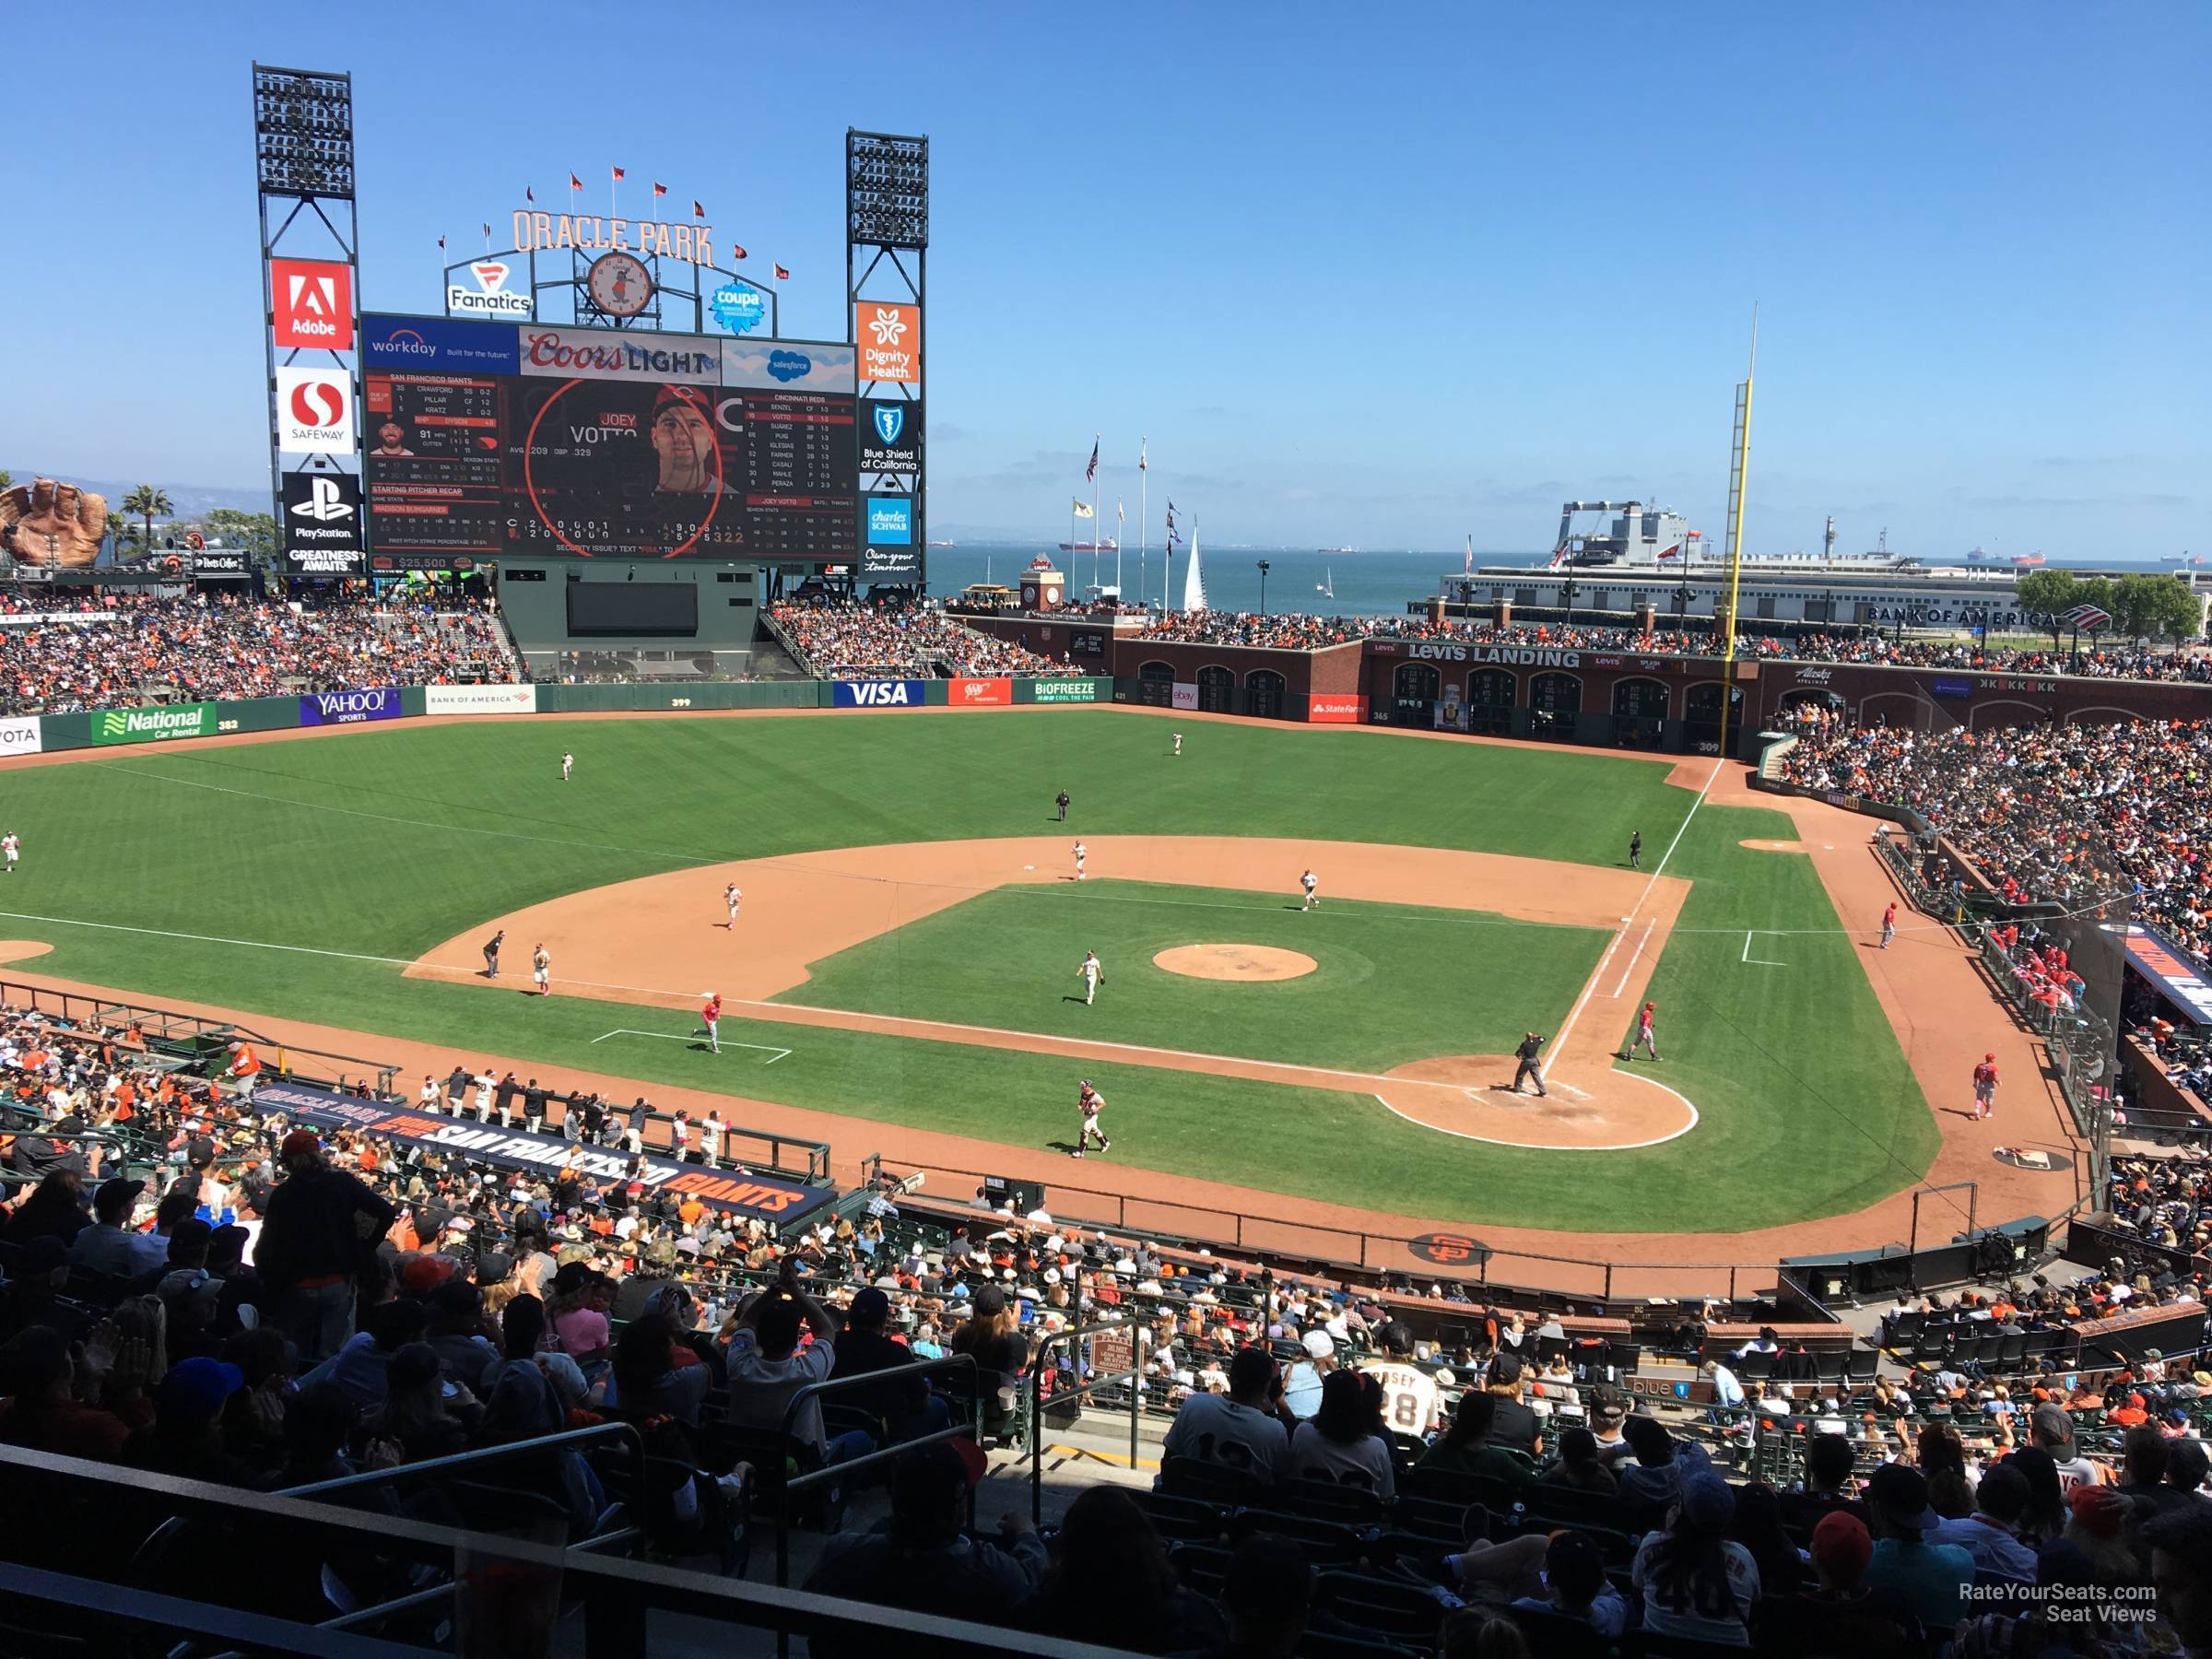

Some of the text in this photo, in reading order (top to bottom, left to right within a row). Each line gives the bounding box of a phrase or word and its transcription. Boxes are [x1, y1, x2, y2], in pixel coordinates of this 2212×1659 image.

[513, 210, 714, 267] ORACLE PARK
[452, 289, 530, 311] Fanatics
[717, 291, 759, 308] coupa
[292, 319, 335, 335] Adobe
[372, 340, 436, 358] workday
[528, 333, 707, 374] Coors LIGHT
[865, 348, 911, 366] Dignity
[772, 360, 807, 371] salesforce
[390, 374, 405, 382] SAN
[406, 375, 445, 383] FRANCISCO
[417, 385, 453, 394] CRAWFORD
[774, 394, 808, 403] CINCINNATI
[601, 415, 636, 426] JOEY
[292, 429, 345, 441] SAFEWAY
[419, 429, 431, 439] 91
[864, 448, 913, 460] Blue Shield
[861, 460, 917, 470] of California
[372, 486, 406, 494] STARTING
[872, 511, 907, 522] charles
[872, 522, 907, 531] SCHWAB
[289, 549, 359, 562] GREATNESS
[865, 548, 913, 564] Own your
[219, 557, 238, 570] Coffee
[399, 557, 446, 568] $25,500
[865, 562, 916, 571] tomorrow
[1868, 606, 2057, 627] BANK OF AMERICA
[1409, 644, 1580, 668] Levi's LANDING
[1795, 666, 1832, 679] Alaska
[847, 682, 909, 705] VISA
[965, 684, 983, 695] AAA
[1173, 689, 1194, 702] ebay
[1114, 692, 1126, 700] 421
[317, 690, 385, 715] YAHOO!
[672, 699, 691, 707] 399
[127, 707, 203, 732] National
[338, 712, 366, 722] SPORTS
[1373, 712, 1388, 721] 365
[218, 720, 238, 730] 382
[154, 727, 200, 739] Car Rental
[1700, 742, 1719, 752] 309
[1828, 793, 1844, 806] KNBR
[253, 1088, 391, 1124] ORACLE PARK
[703, 1127, 712, 1136] 31
[422, 1125, 805, 1212] SAN FRANCISCO GIANTS
[2112, 1240, 2163, 1258] LEXUS
[1633, 1379, 1671, 1394] blue
